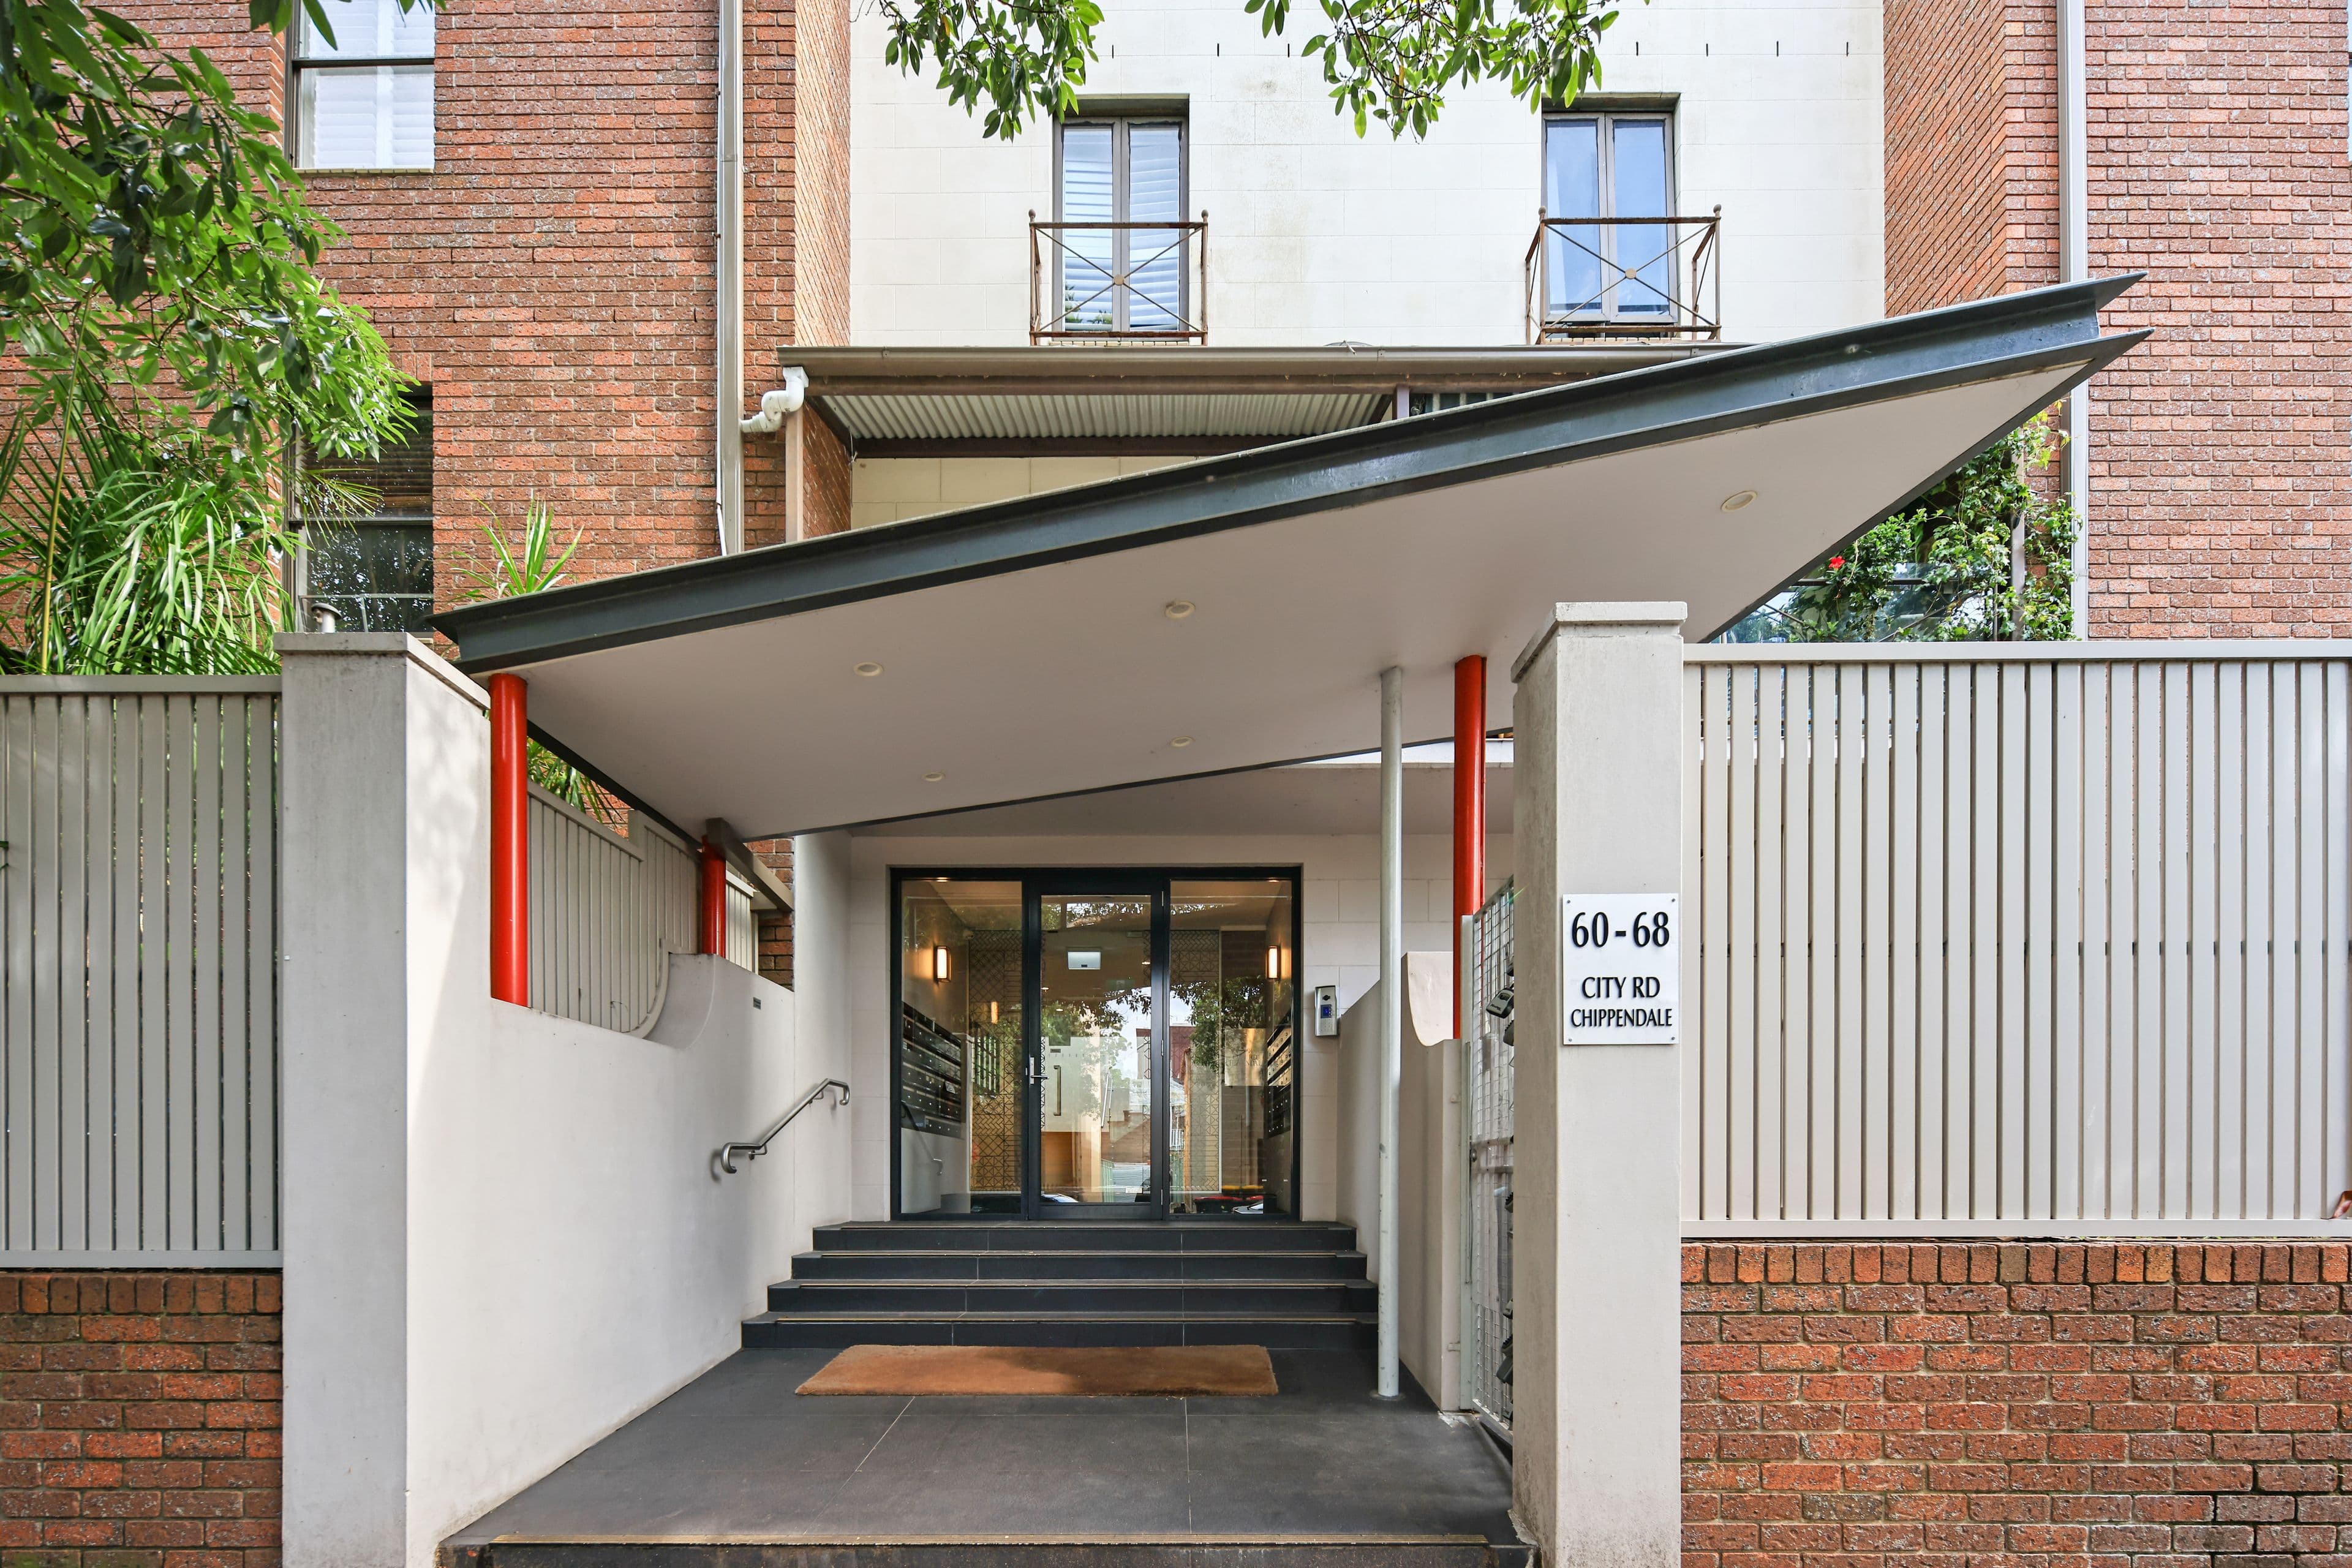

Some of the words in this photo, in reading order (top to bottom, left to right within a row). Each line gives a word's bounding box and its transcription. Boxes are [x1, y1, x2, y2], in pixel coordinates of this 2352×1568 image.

[1572, 911, 1670, 948] 60-68
[1581, 976, 1627, 998] CITY
[1632, 976, 1660, 998] RD
[1570, 1008, 1672, 1027] CHIPPENDALE
